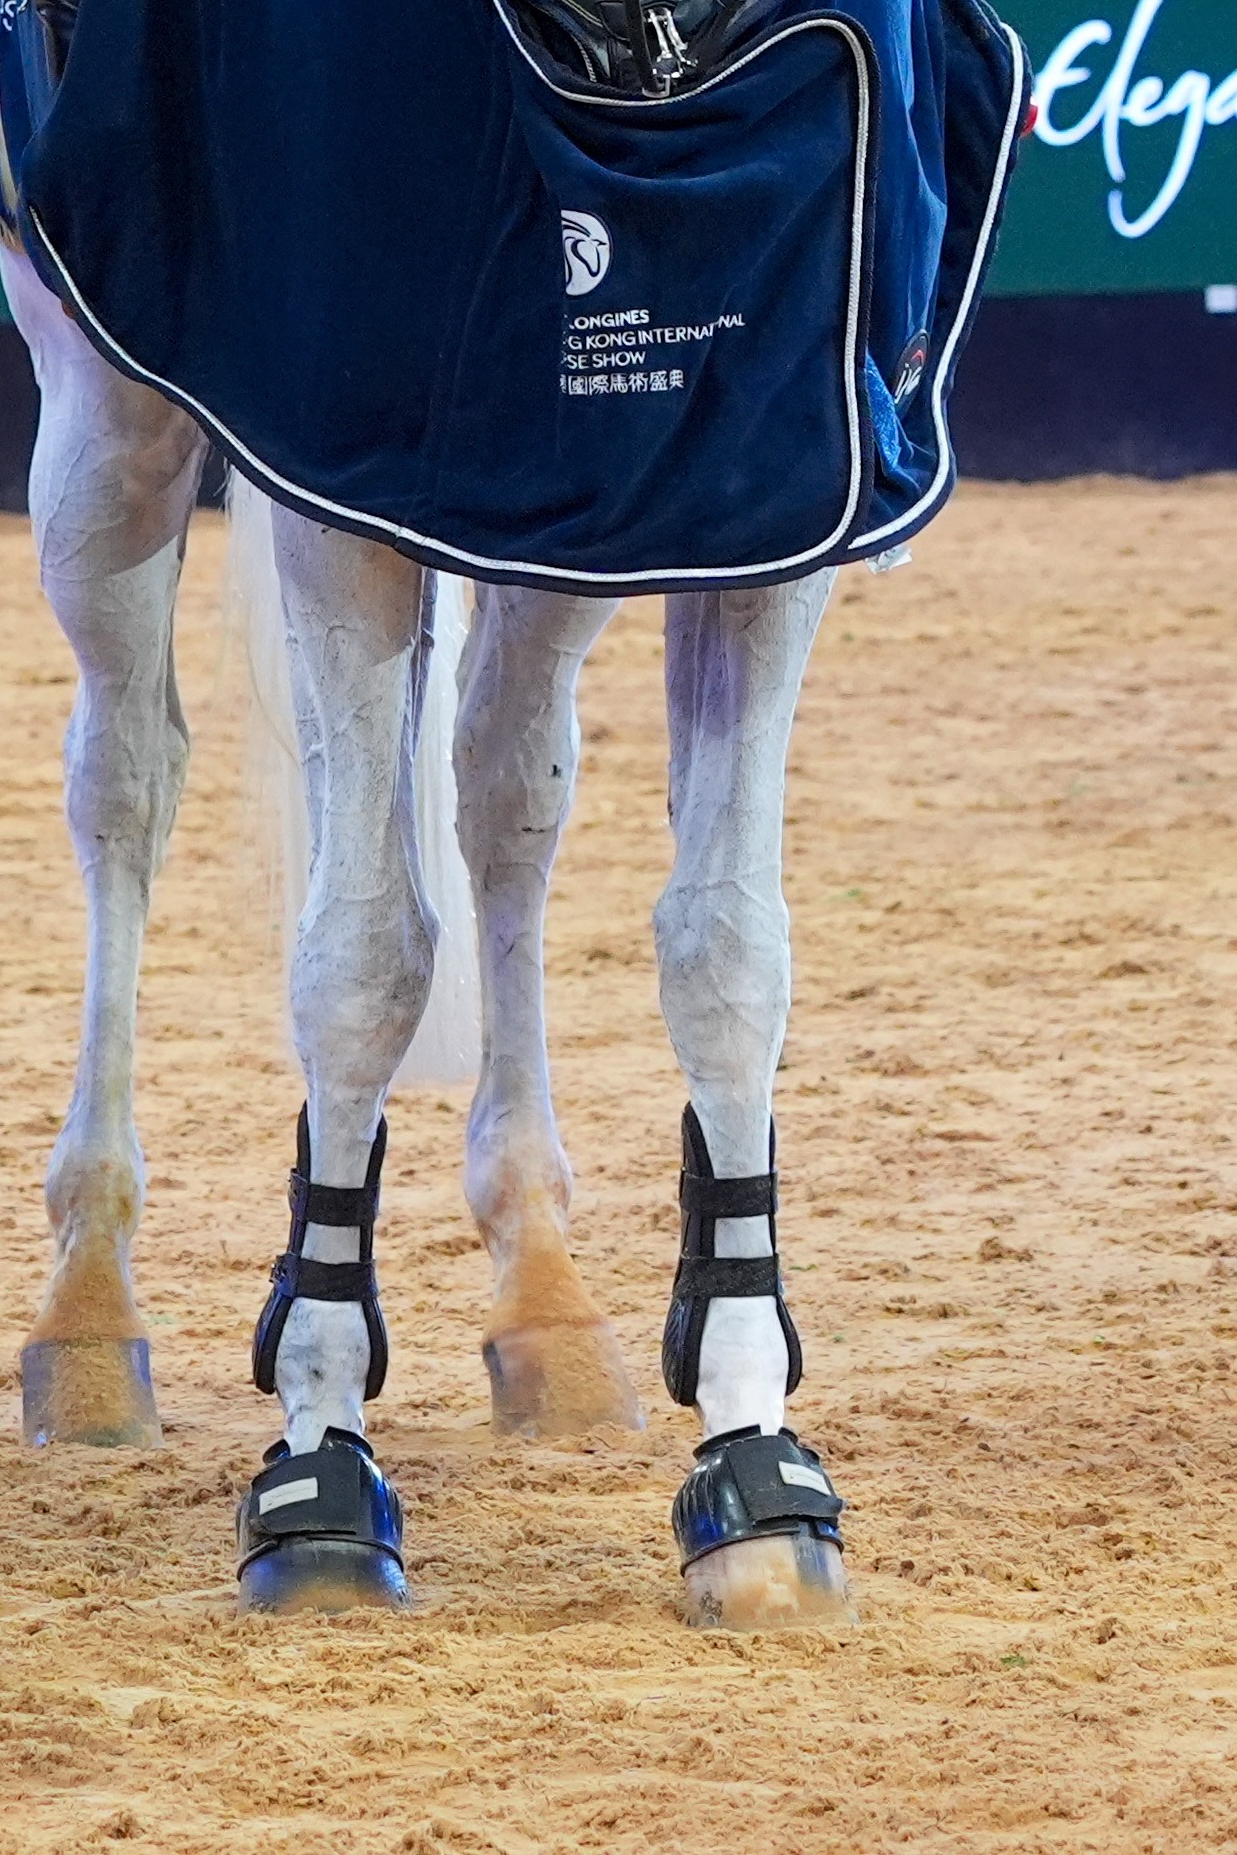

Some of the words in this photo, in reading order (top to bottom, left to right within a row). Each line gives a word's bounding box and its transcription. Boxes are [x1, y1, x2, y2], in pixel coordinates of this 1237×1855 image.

[566, 308, 650, 330] ONGINES
[585, 331, 637, 350] KONG
[592, 350, 646, 368] SHOW
